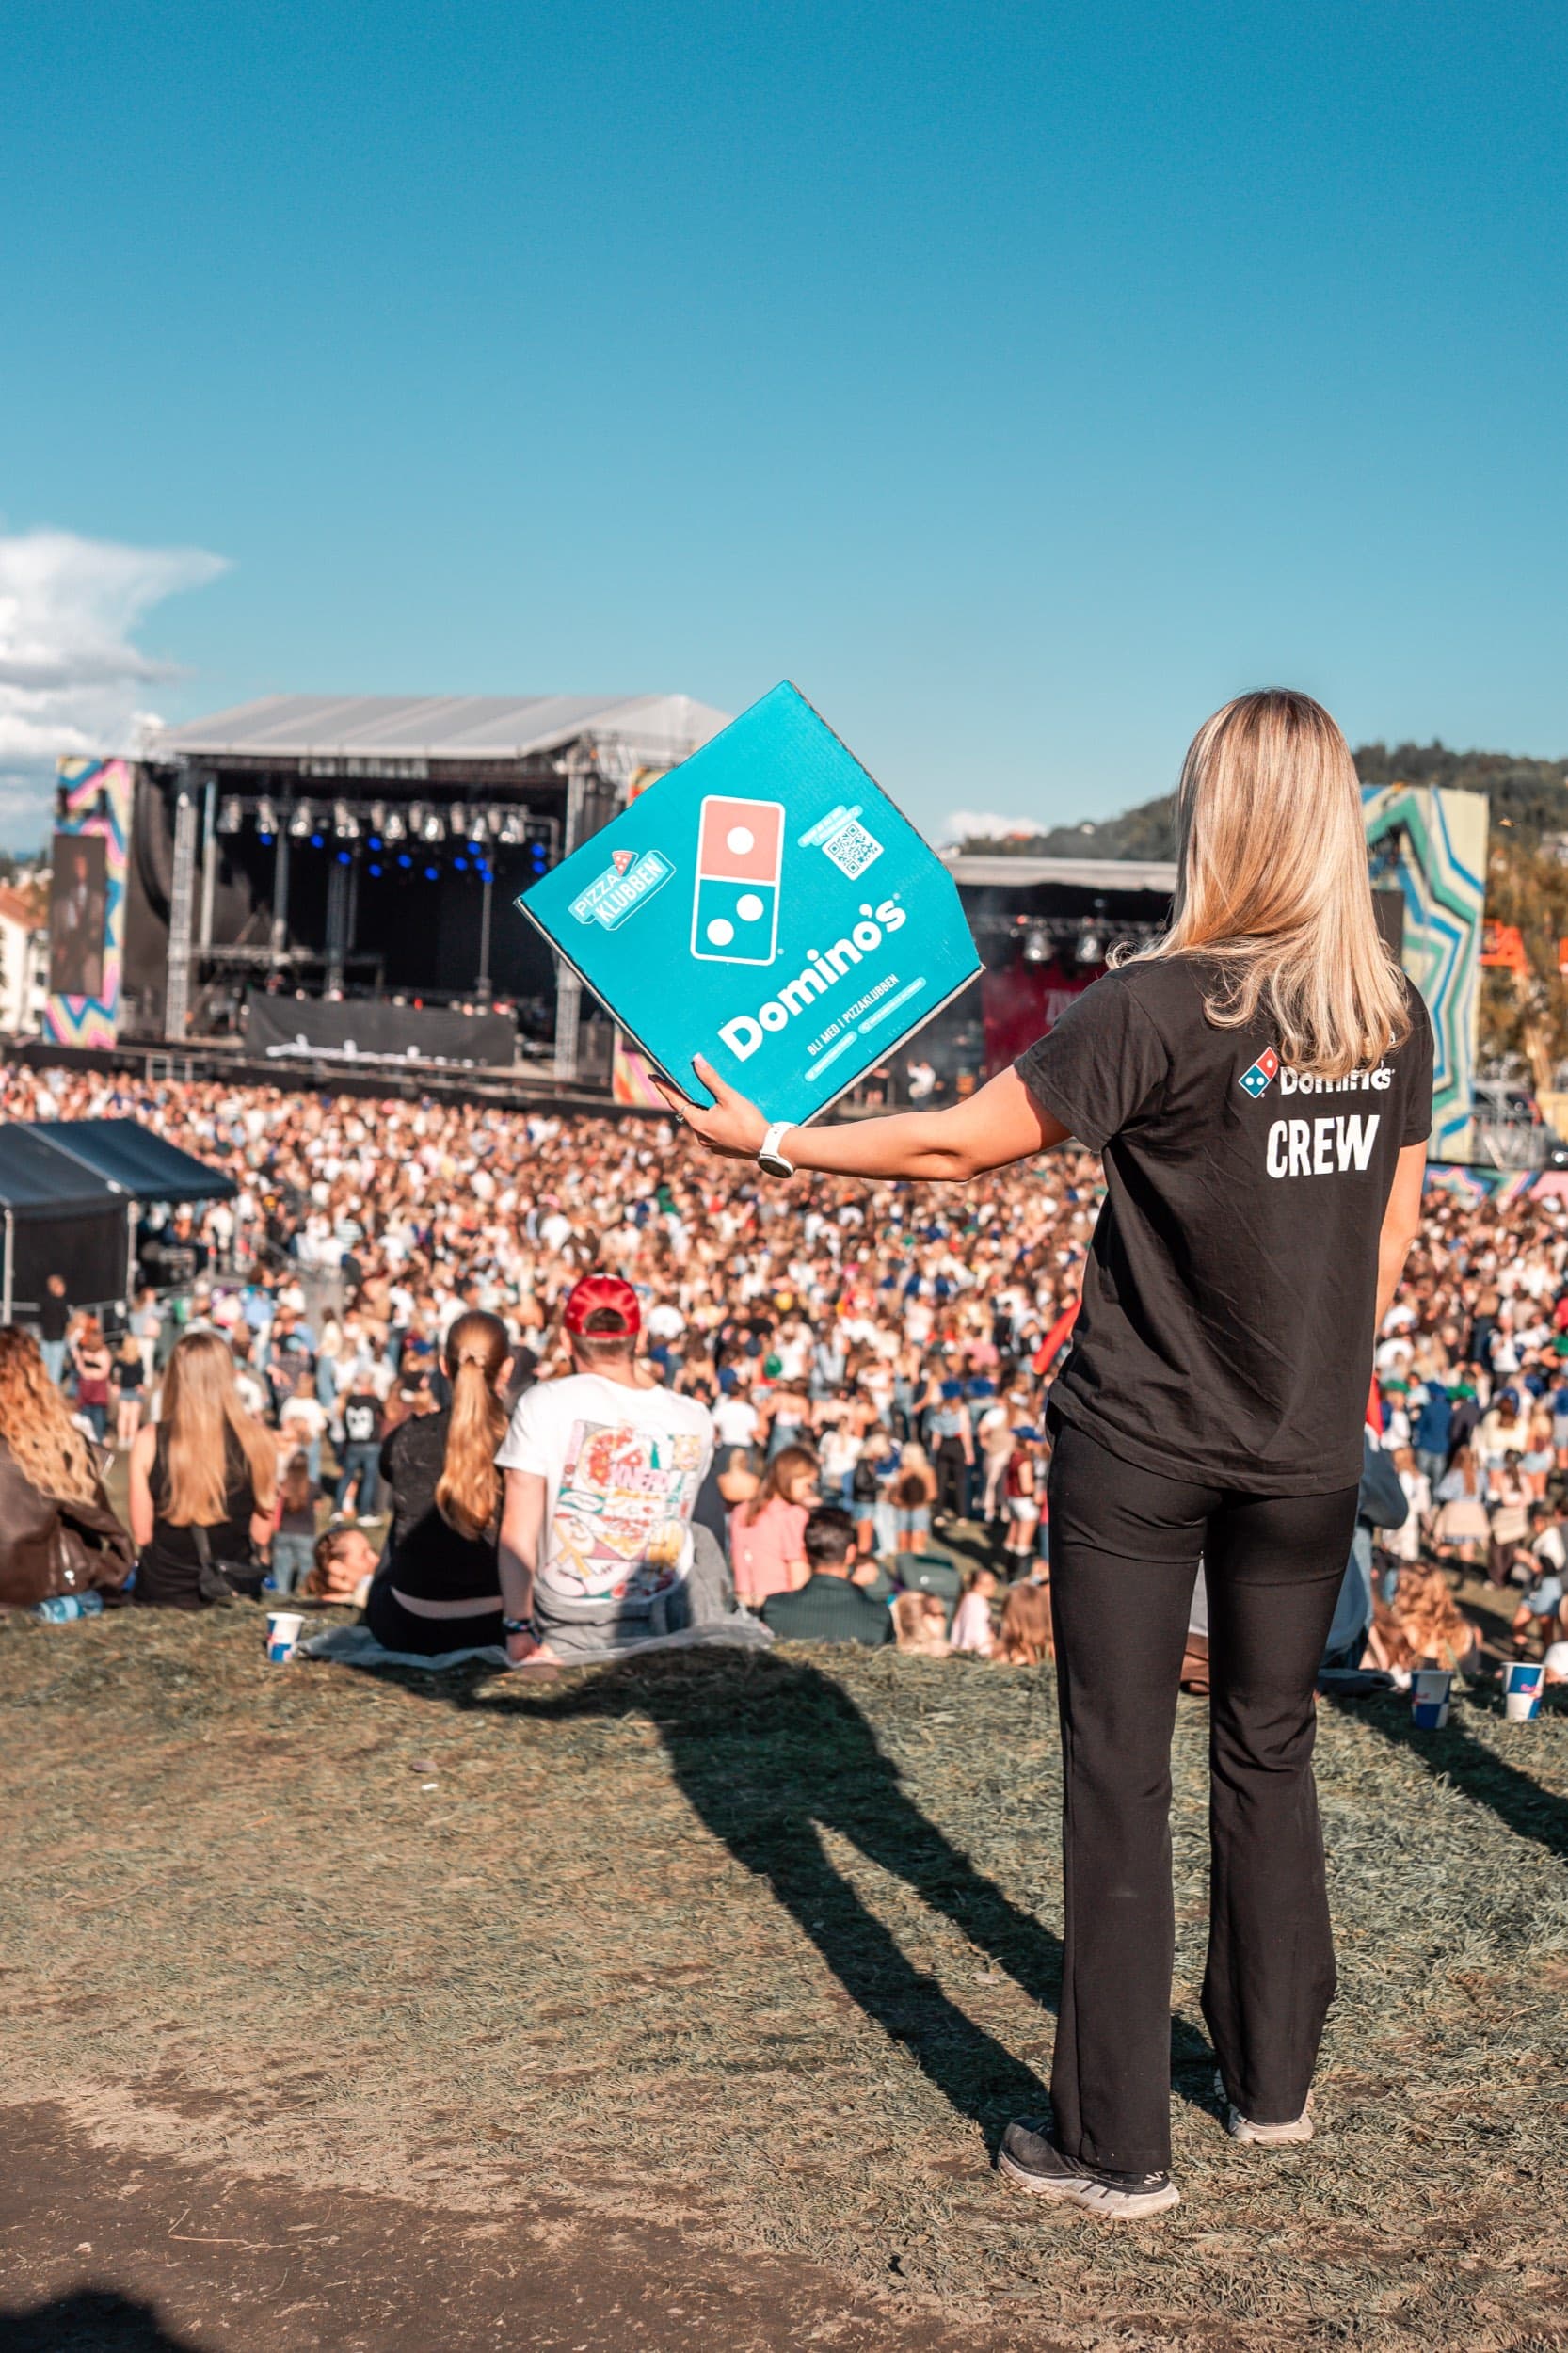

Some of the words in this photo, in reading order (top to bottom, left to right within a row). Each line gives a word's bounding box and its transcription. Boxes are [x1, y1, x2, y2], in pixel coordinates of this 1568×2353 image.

[574, 873, 621, 917] PIZZA
[595, 857, 663, 923] KLUBBEN
[717, 899, 907, 1062] Domino's
[807, 1038, 824, 1056] BLI
[820, 1023, 840, 1044] MED
[837, 1018, 845, 1028] I
[841, 973, 900, 1023] PIZZAKLUBBEN
[1266, 1114, 1381, 1178] CREW
